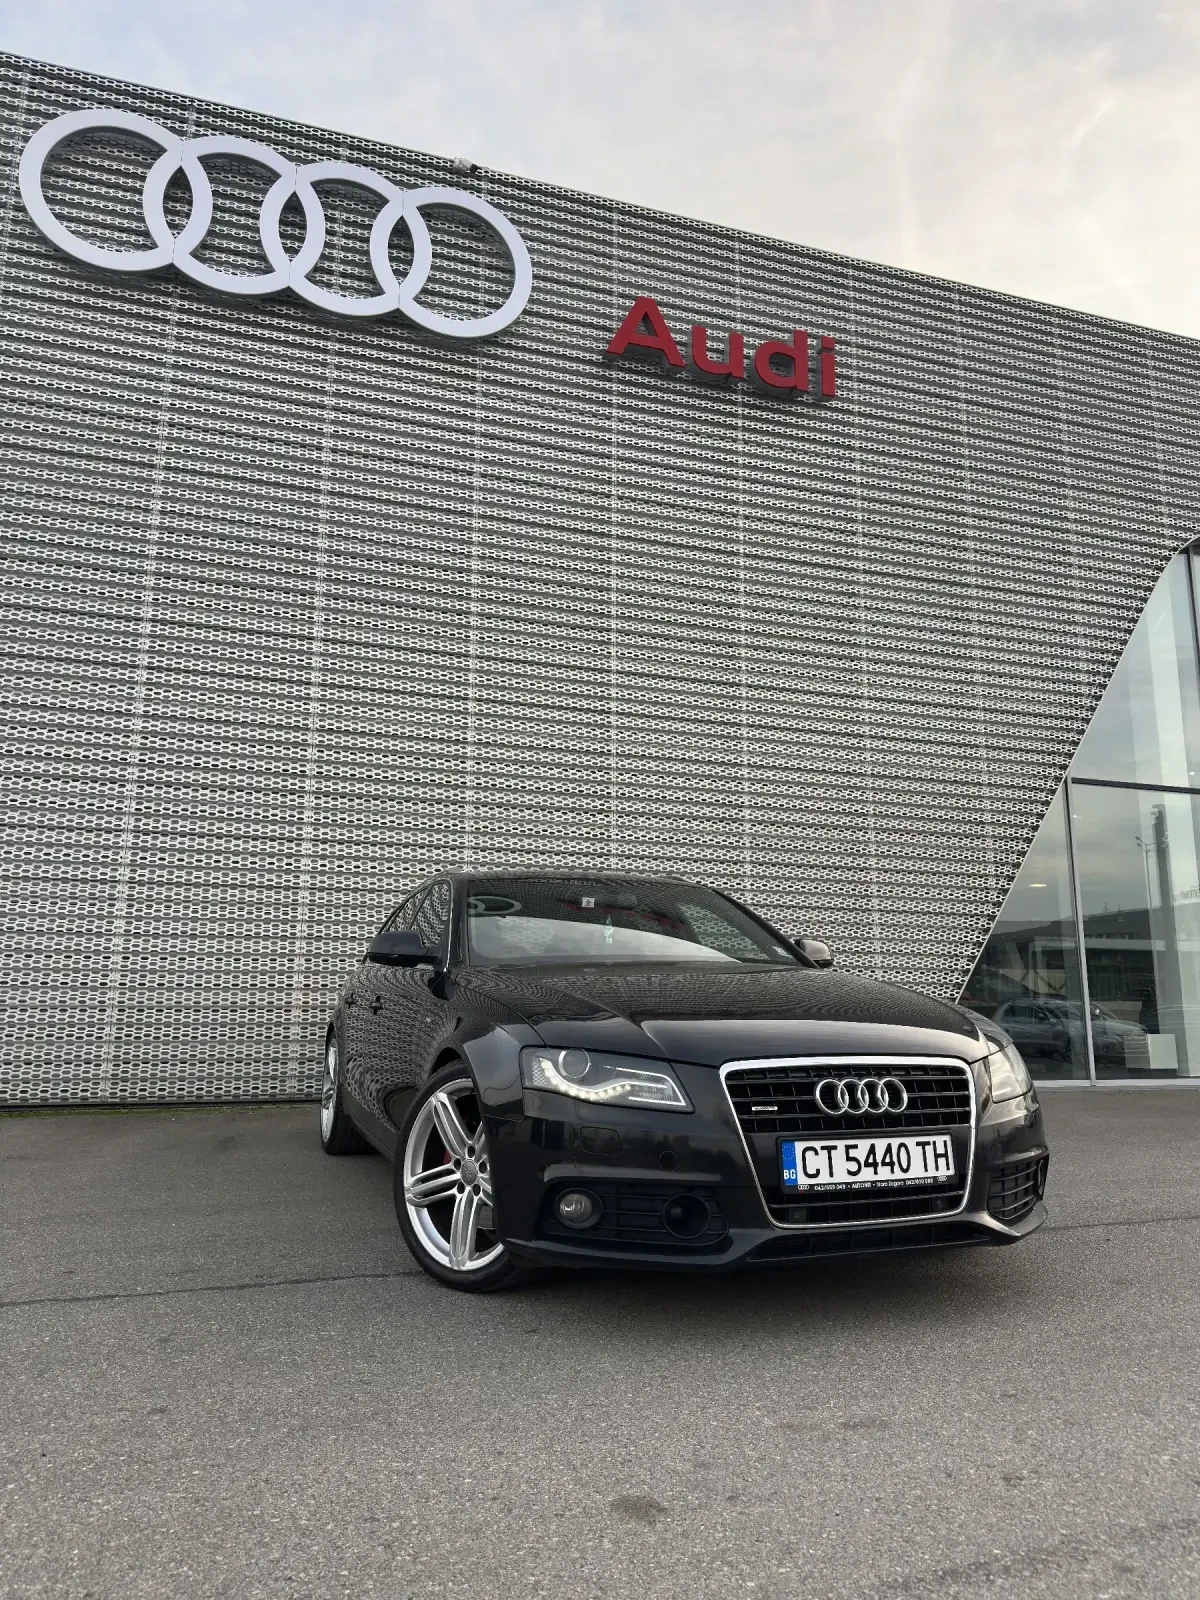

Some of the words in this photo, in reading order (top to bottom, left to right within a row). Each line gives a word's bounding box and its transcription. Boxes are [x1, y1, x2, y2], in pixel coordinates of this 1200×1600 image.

[605, 296, 836, 398] Audi
[783, 1169, 796, 1180] BG
[801, 1145, 838, 1179] CT
[844, 1142, 912, 1177] 5440
[915, 1139, 951, 1173] TH
